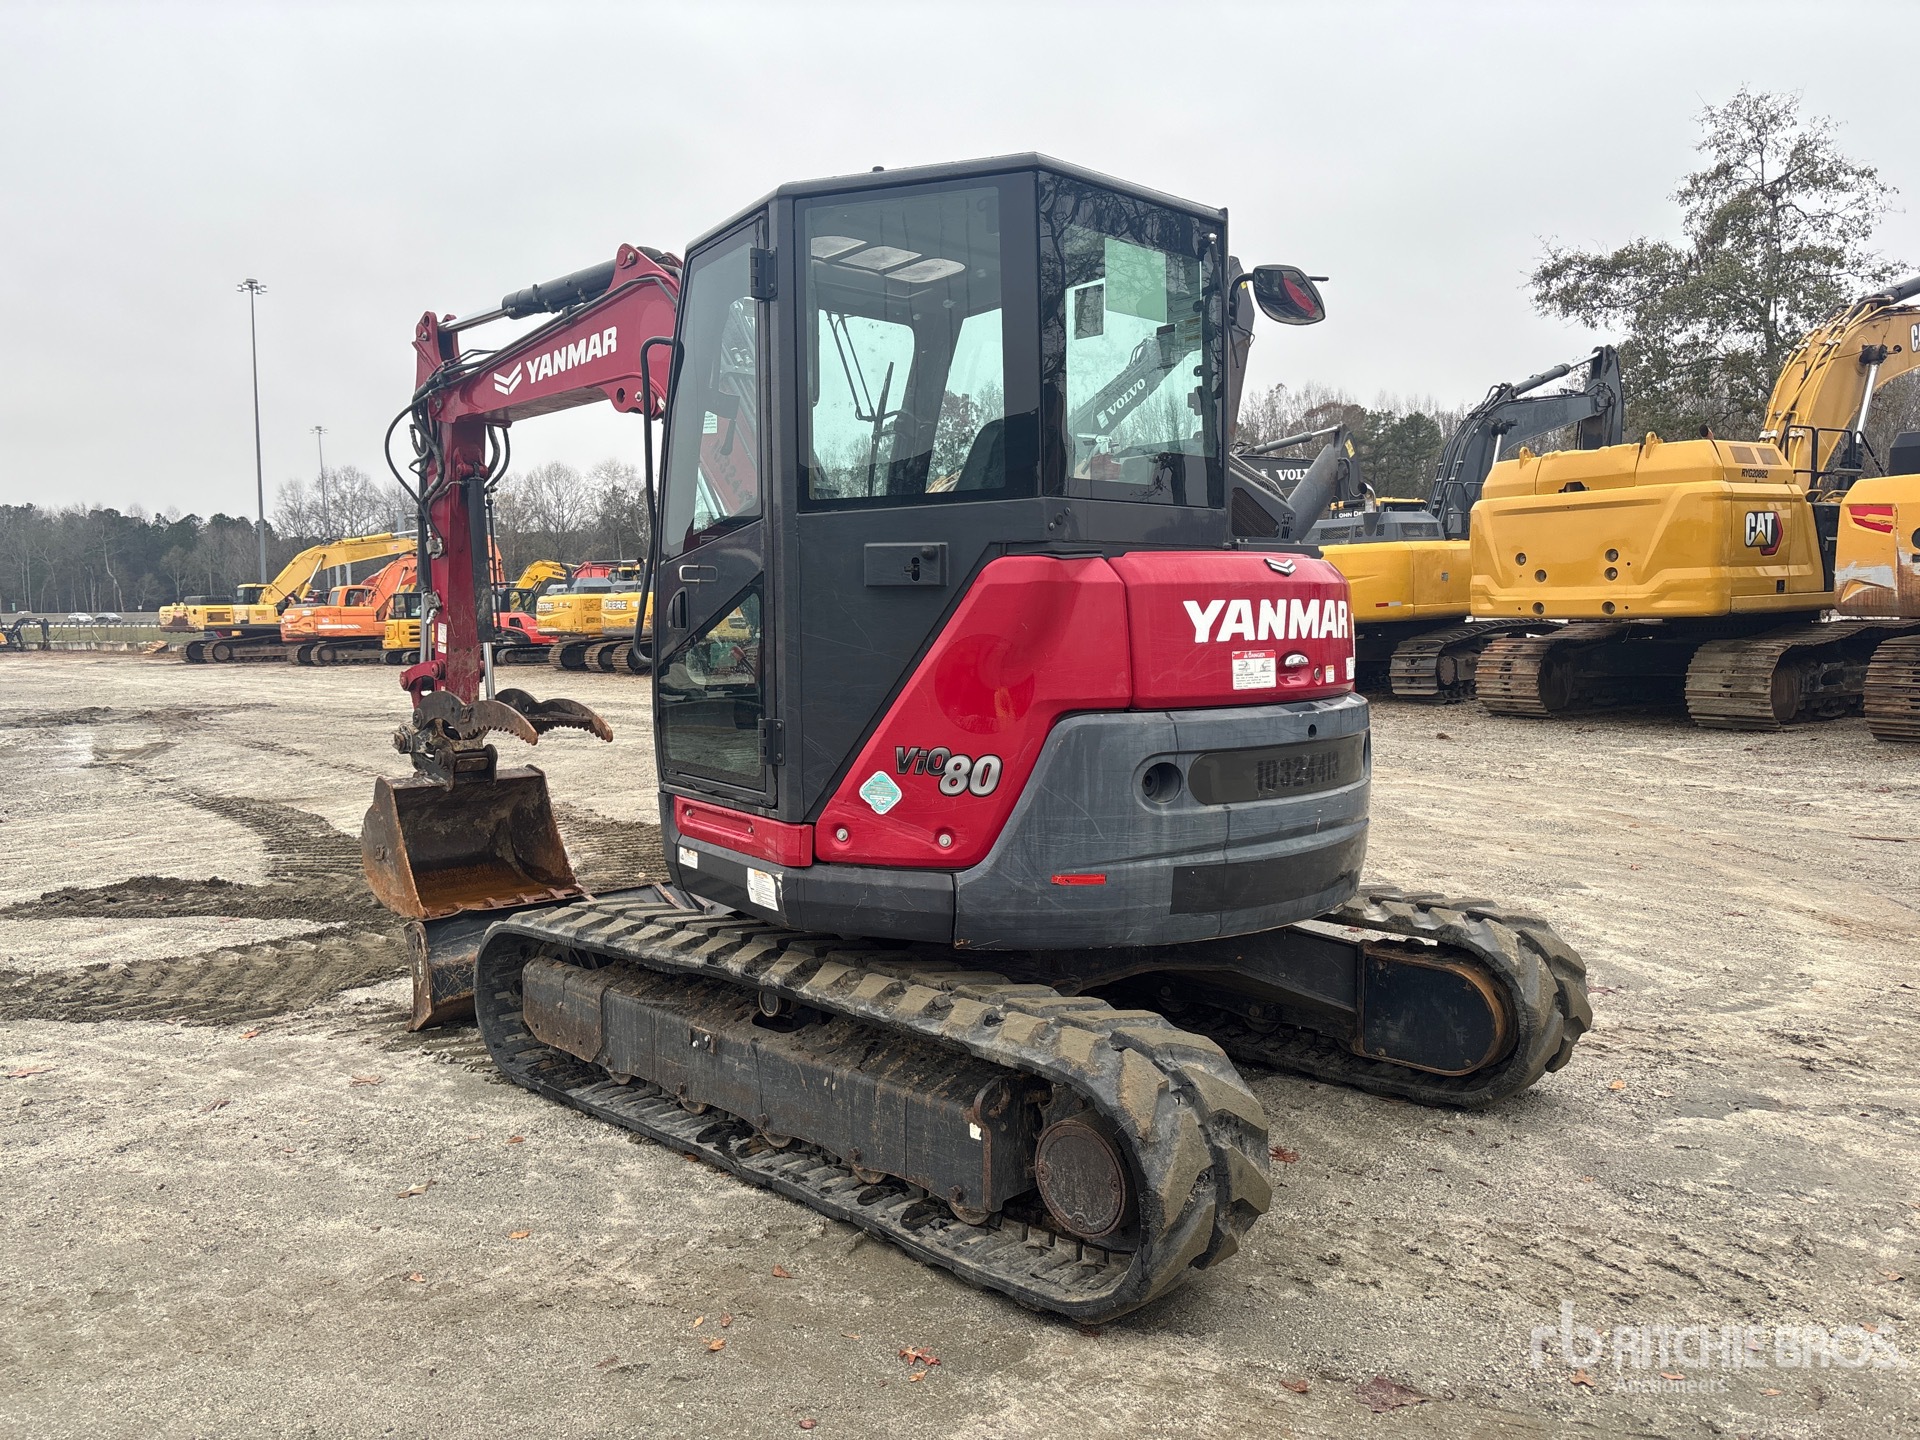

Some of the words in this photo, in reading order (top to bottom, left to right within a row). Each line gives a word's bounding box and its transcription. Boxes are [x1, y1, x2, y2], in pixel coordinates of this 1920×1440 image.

[526, 326, 617, 384] YANMAR
[1107, 379, 1146, 415] VOLVO
[1745, 512, 1774, 547] CAT
[605, 600, 627, 610] DEERE
[1183, 599, 1348, 643] YANMAR
